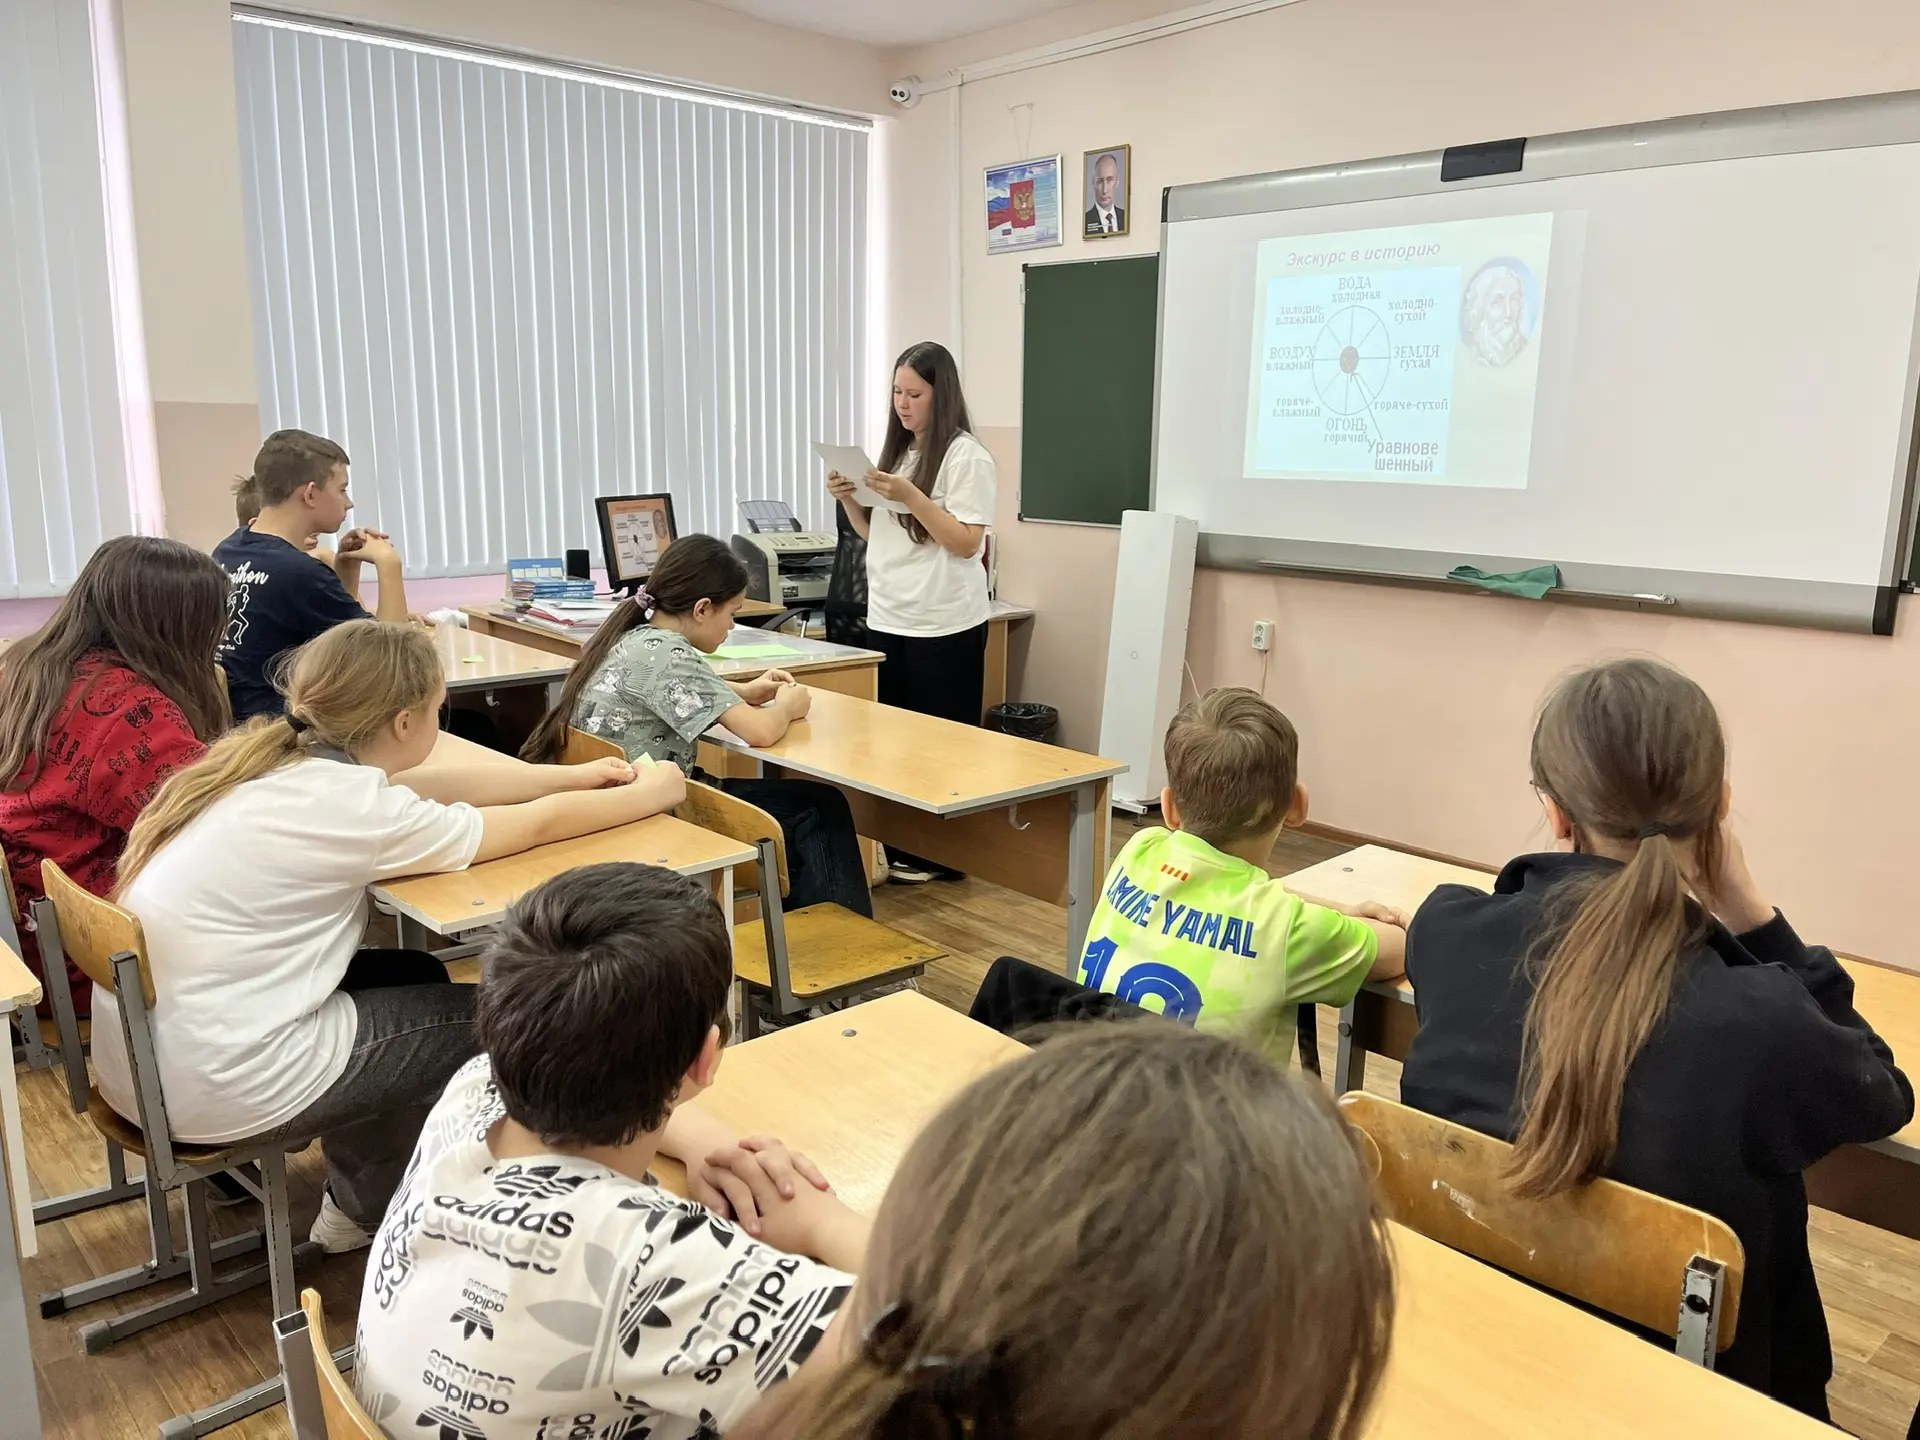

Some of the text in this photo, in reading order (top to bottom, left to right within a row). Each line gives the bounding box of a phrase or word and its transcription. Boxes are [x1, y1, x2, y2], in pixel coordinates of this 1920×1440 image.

[1286, 242, 1441, 267] Экскурс в историю
[1338, 275, 1372, 292] ВОДА
[1331, 290, 1381, 303] холодная
[1275, 313, 1325, 325] влажный
[1394, 309, 1426, 325] сухой
[1269, 345, 1316, 360] ВОЗДУХ
[1393, 344, 1441, 359] ЗЕМЛЯ
[1374, 398, 1448, 412] горяче-сухой
[1326, 418, 1368, 431] ОГОНЬ
[1367, 438, 1438, 457] Уравнове
[1374, 457, 1434, 472] шенный
[1161, 899, 1258, 959] YAMAL
[433, 1195, 575, 1238] adidas
[461, 1288, 505, 1313] adidas
[694, 1258, 800, 1385] adidas
[421, 1369, 510, 1415] adidas
